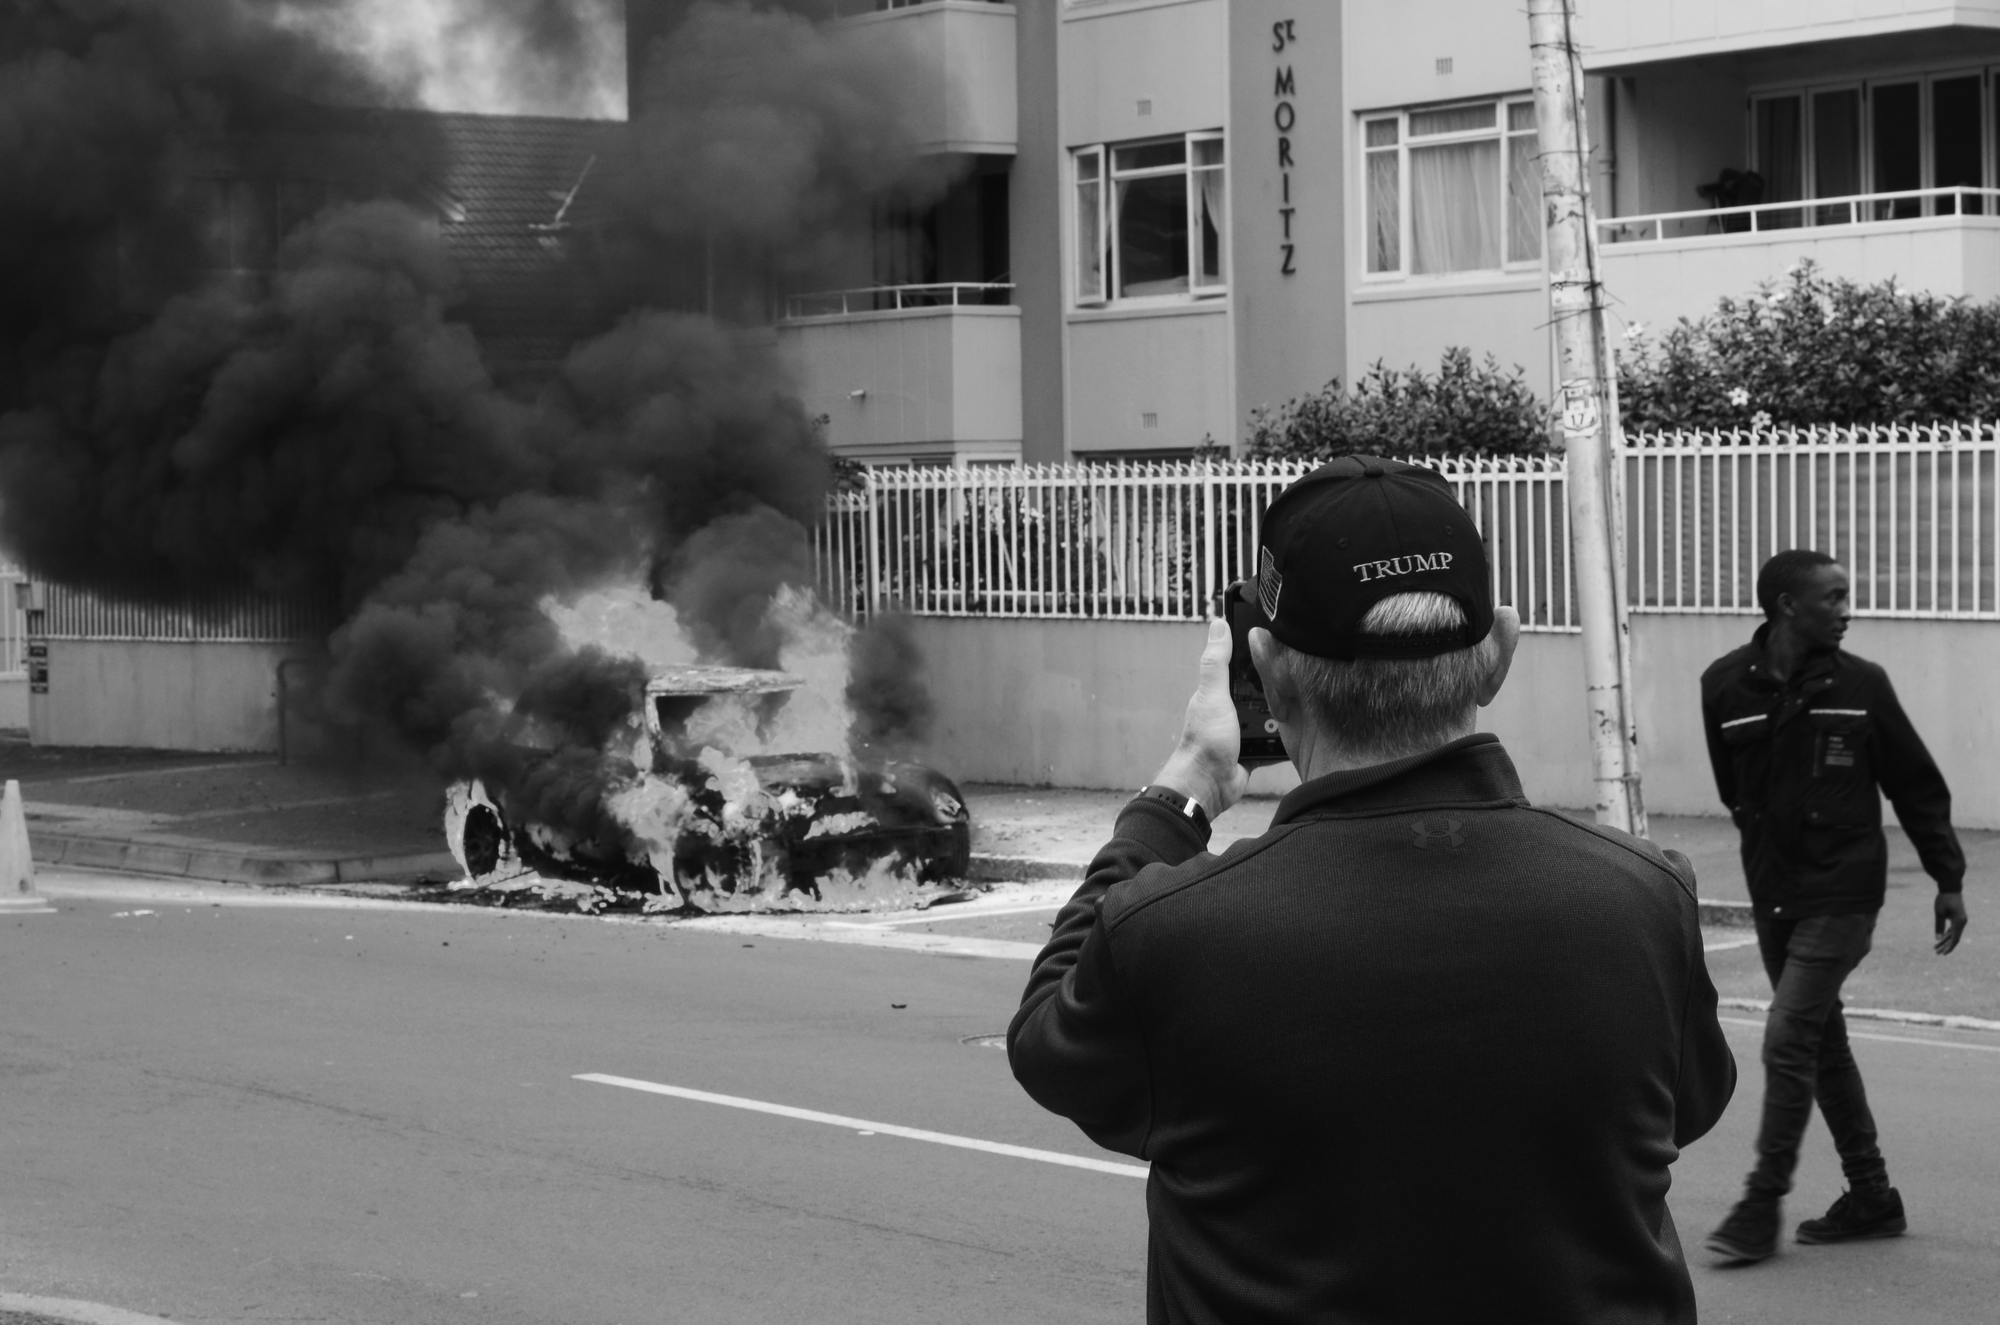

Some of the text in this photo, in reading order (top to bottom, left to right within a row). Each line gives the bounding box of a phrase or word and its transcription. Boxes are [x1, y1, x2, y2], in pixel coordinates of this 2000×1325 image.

[1274, 65, 1297, 277] MORITZ
[1571, 413, 1584, 426] 17
[1352, 551, 1453, 582] TRUMP
